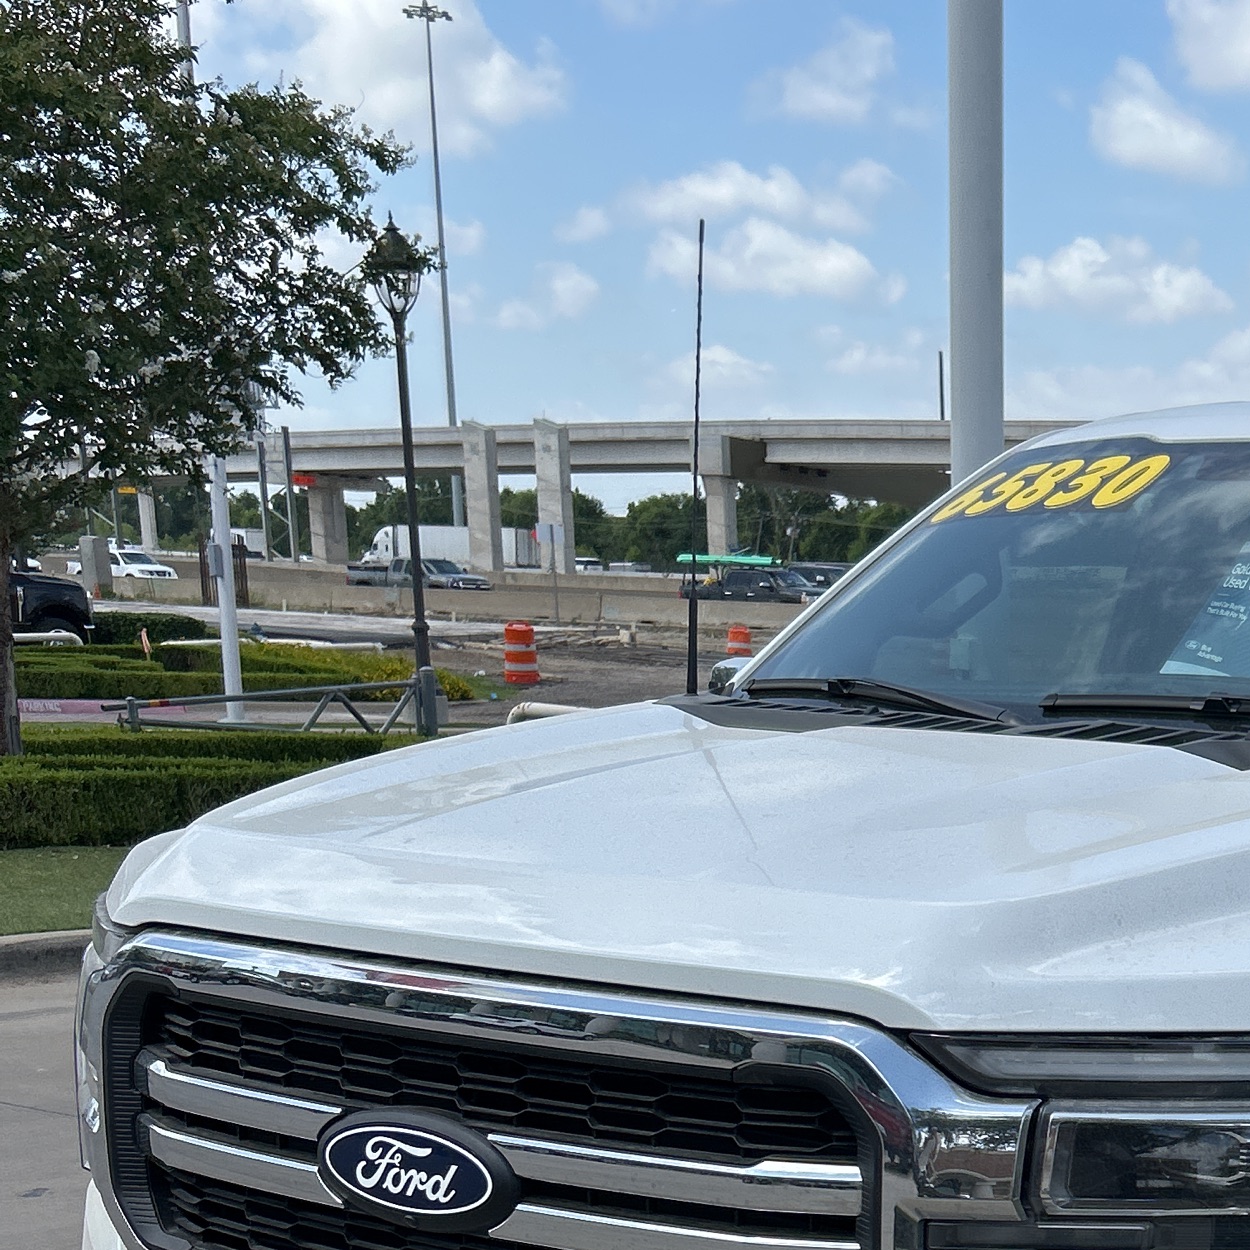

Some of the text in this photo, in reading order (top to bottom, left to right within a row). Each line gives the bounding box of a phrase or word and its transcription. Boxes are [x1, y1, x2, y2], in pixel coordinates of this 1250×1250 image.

[931, 455, 1170, 523] 65830
[1222, 575, 1249, 589] Used
[355, 1135, 459, 1204] Ford
